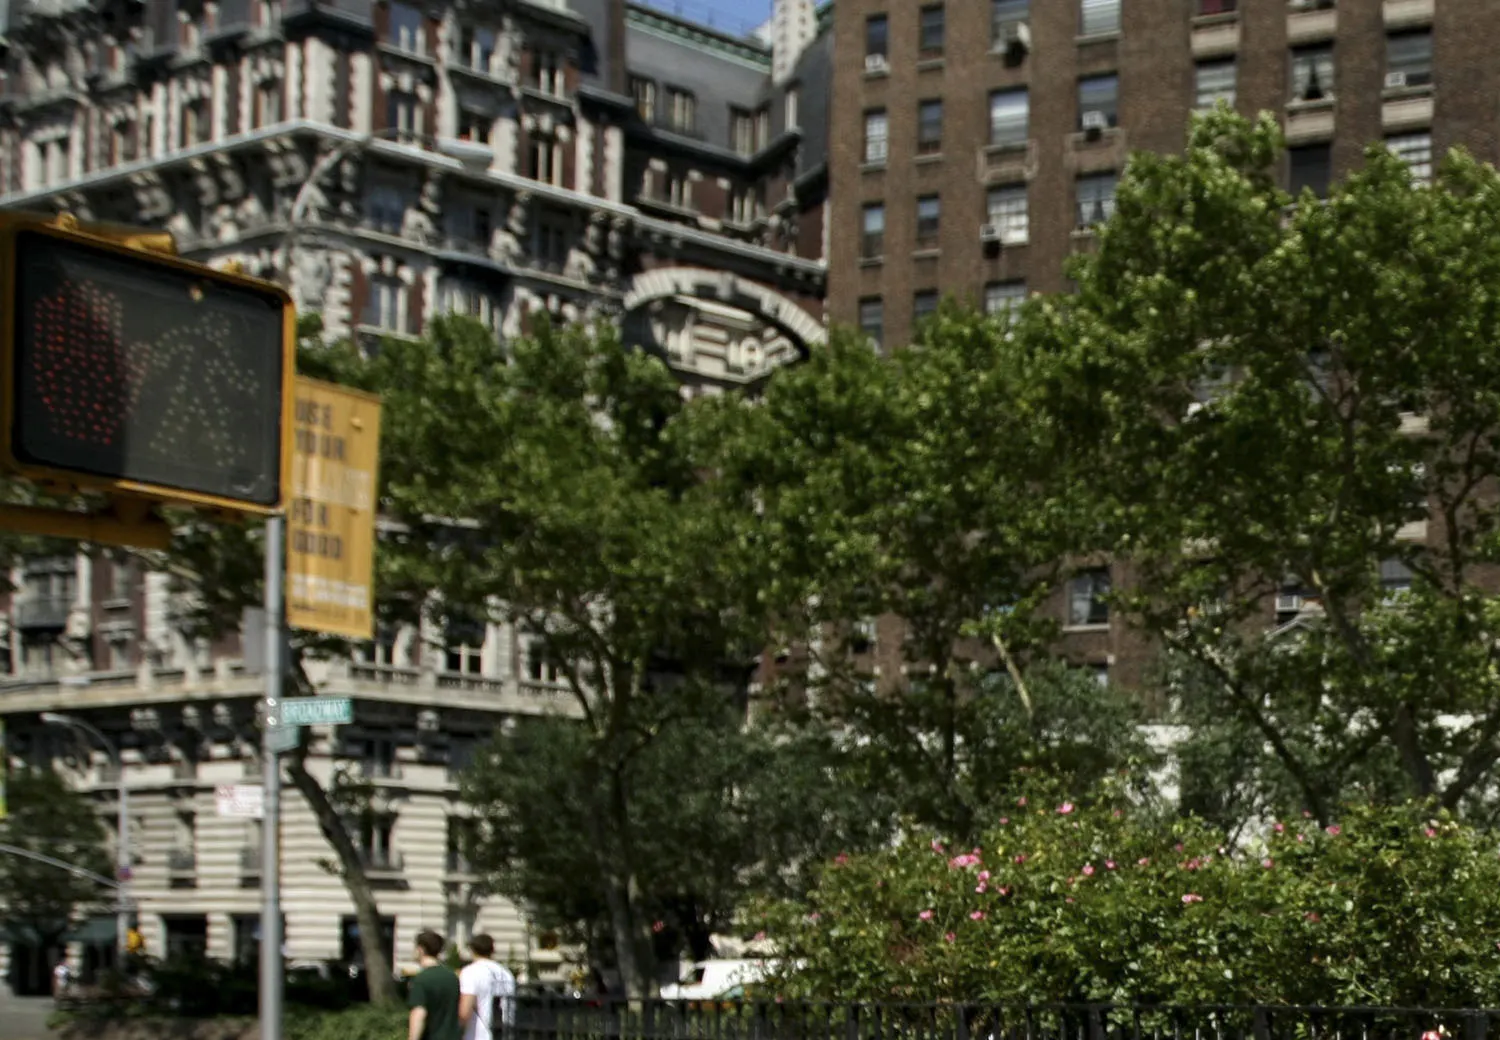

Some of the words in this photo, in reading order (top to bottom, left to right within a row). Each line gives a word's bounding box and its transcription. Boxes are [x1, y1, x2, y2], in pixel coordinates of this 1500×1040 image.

[296, 429, 346, 460] YOUR
[293, 498, 328, 527] FOR
[294, 531, 344, 559] GOOD
[283, 702, 346, 723] BROADWAY
